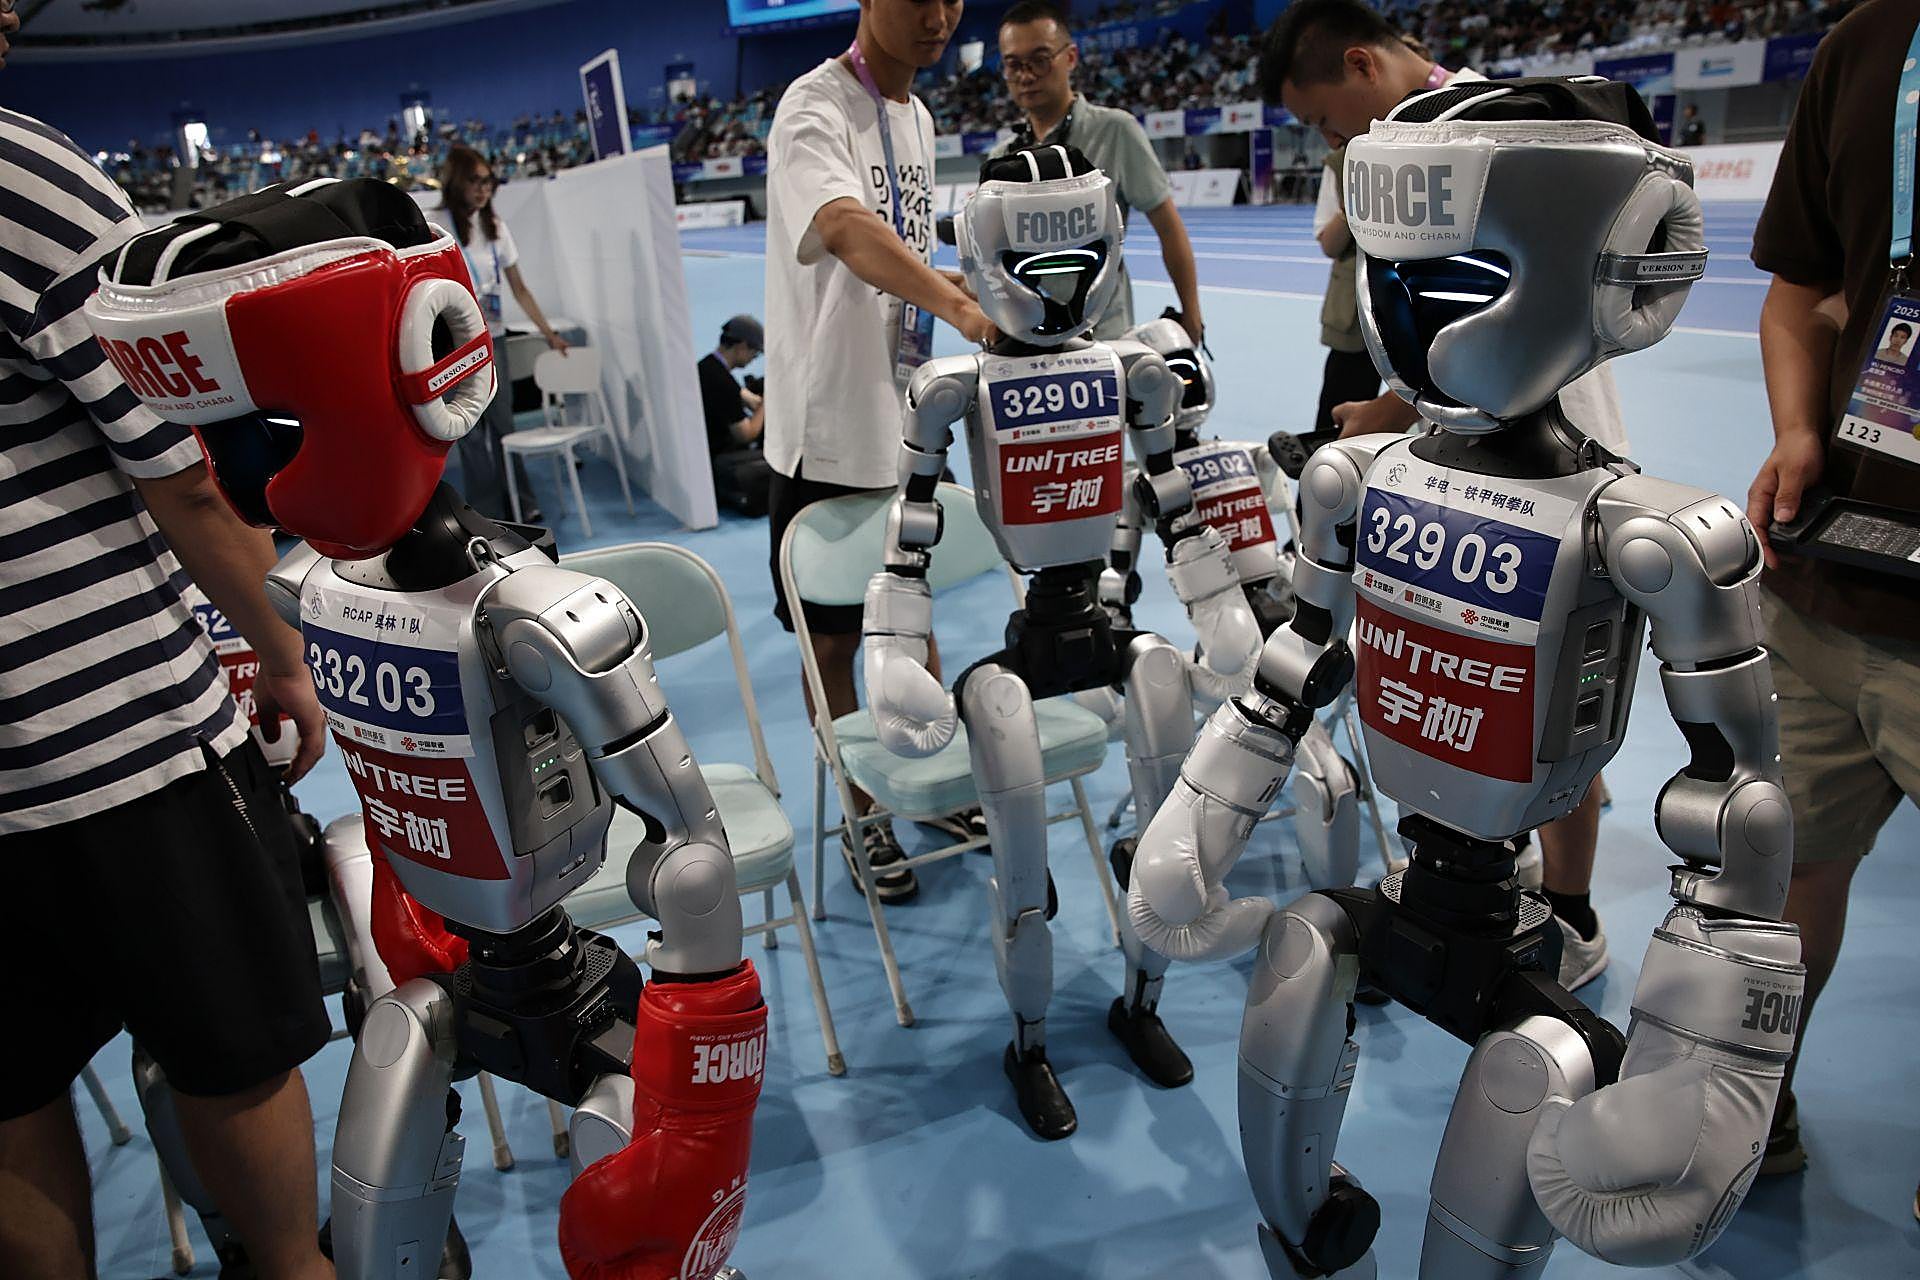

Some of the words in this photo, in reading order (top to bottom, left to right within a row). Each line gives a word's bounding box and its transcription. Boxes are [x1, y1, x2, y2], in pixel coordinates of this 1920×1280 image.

[1348, 159, 1455, 227] FORCE
[1016, 203, 1097, 243] FORCE
[1394, 232, 1416, 241] AND
[1420, 232, 1461, 241] CHARM
[1642, 264, 1684, 272] VERSION
[1690, 263, 1702, 272] 2.0
[97, 330, 221, 398] ORCE
[431, 361, 467, 388] VERSION
[471, 351, 484, 364] 2.0
[197, 396, 234, 408] CHARM
[1845, 422, 1881, 444] 123
[1005, 444, 1119, 475] UNITREE
[1031, 475, 1104, 514] 宇树
[342, 606, 373, 624] RCAP
[1360, 616, 1527, 693] UNITREE
[1377, 676, 1485, 753] 宇树
[337, 744, 467, 802] NITREE
[364, 793, 451, 860] 宇树
[691, 1033, 765, 1084] FORCE
